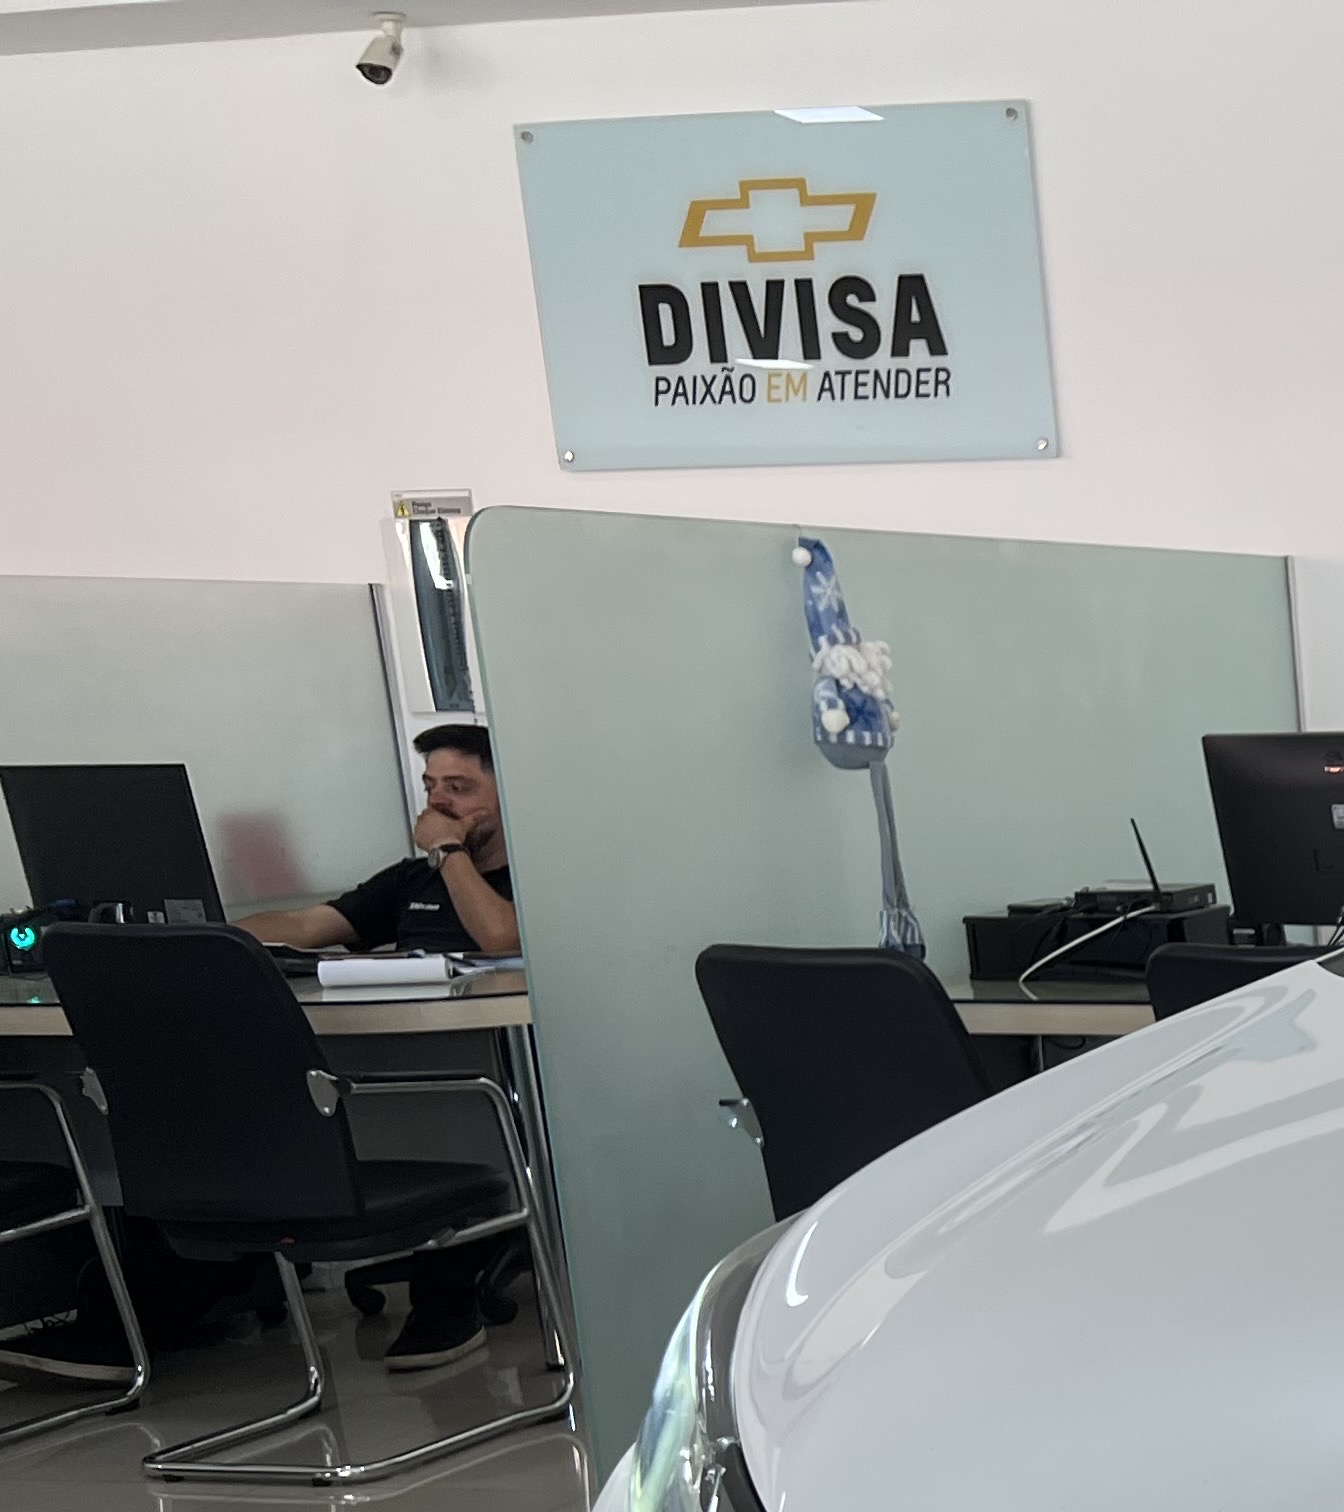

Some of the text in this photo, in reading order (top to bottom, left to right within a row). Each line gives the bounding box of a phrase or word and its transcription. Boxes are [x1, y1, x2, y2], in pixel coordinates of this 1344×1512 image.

[637, 273, 949, 365] DIVISA
[653, 366, 952, 406] PAIXÃO EM ATENDER
